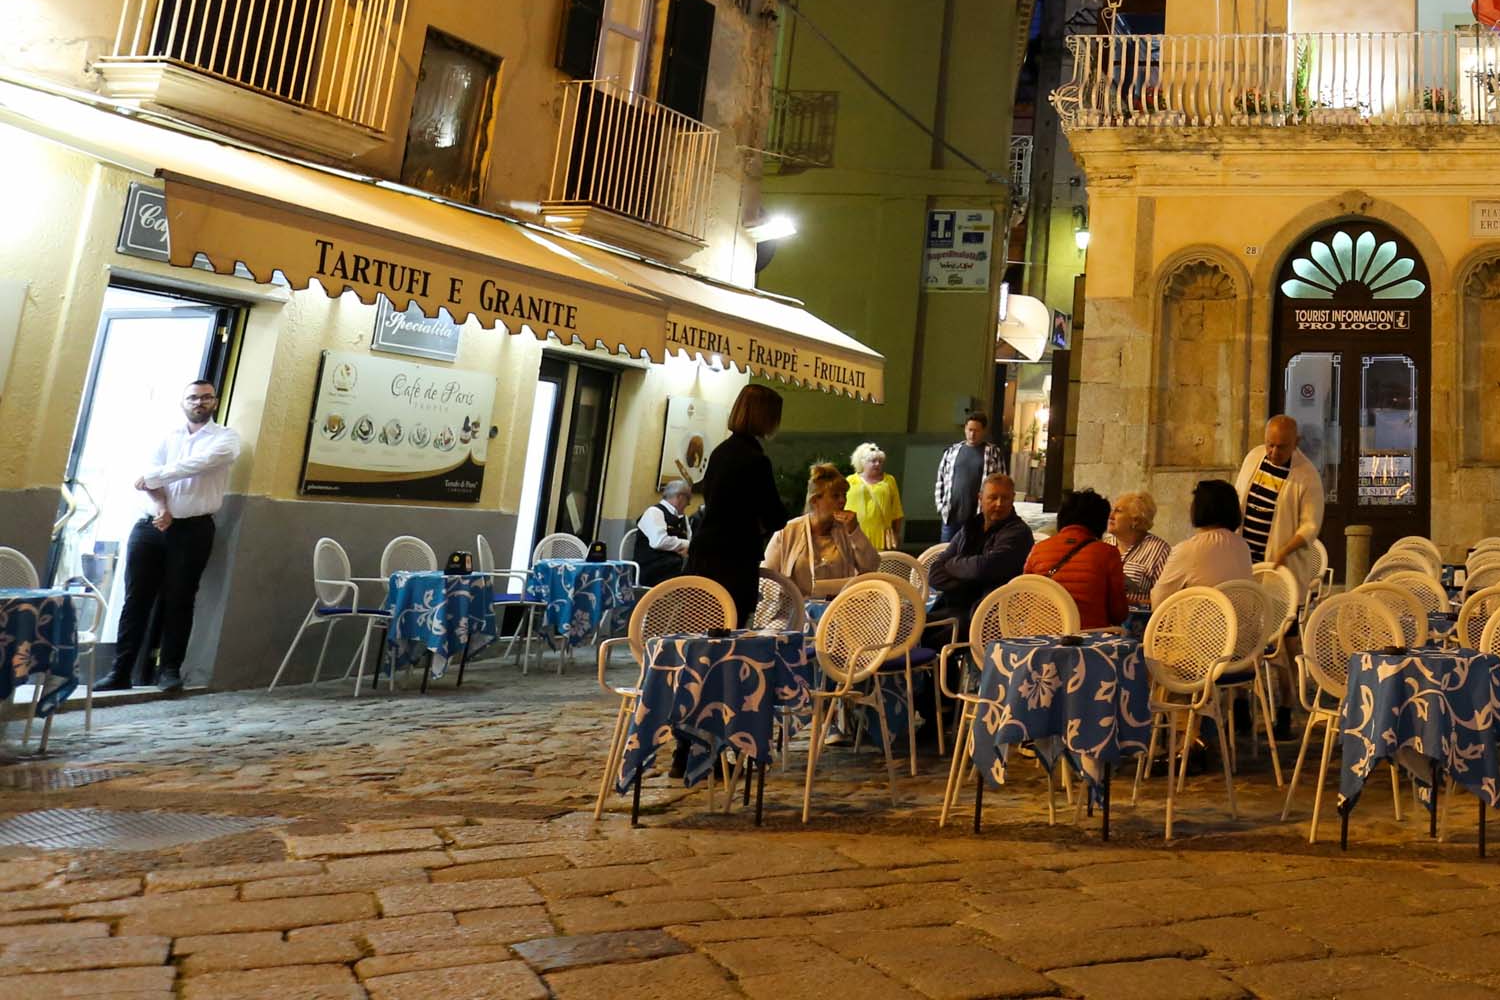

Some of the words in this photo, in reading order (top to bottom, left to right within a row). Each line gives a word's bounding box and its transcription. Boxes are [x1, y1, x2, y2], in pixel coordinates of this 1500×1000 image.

[315, 239, 431, 298] TARTUFI
[447, 277, 464, 305] E
[479, 278, 578, 330] GRANITE
[1295, 309, 1330, 322] TOURIST
[1332, 309, 1394, 322] INFORMATION
[1298, 322, 1336, 330] PRO
[1340, 322, 1392, 330] LOCO
[665, 321, 732, 356] ELATERIA
[814, 356, 865, 389] FRULLATI
[424, 382, 438, 401] de
[441, 381, 475, 406] Paris
